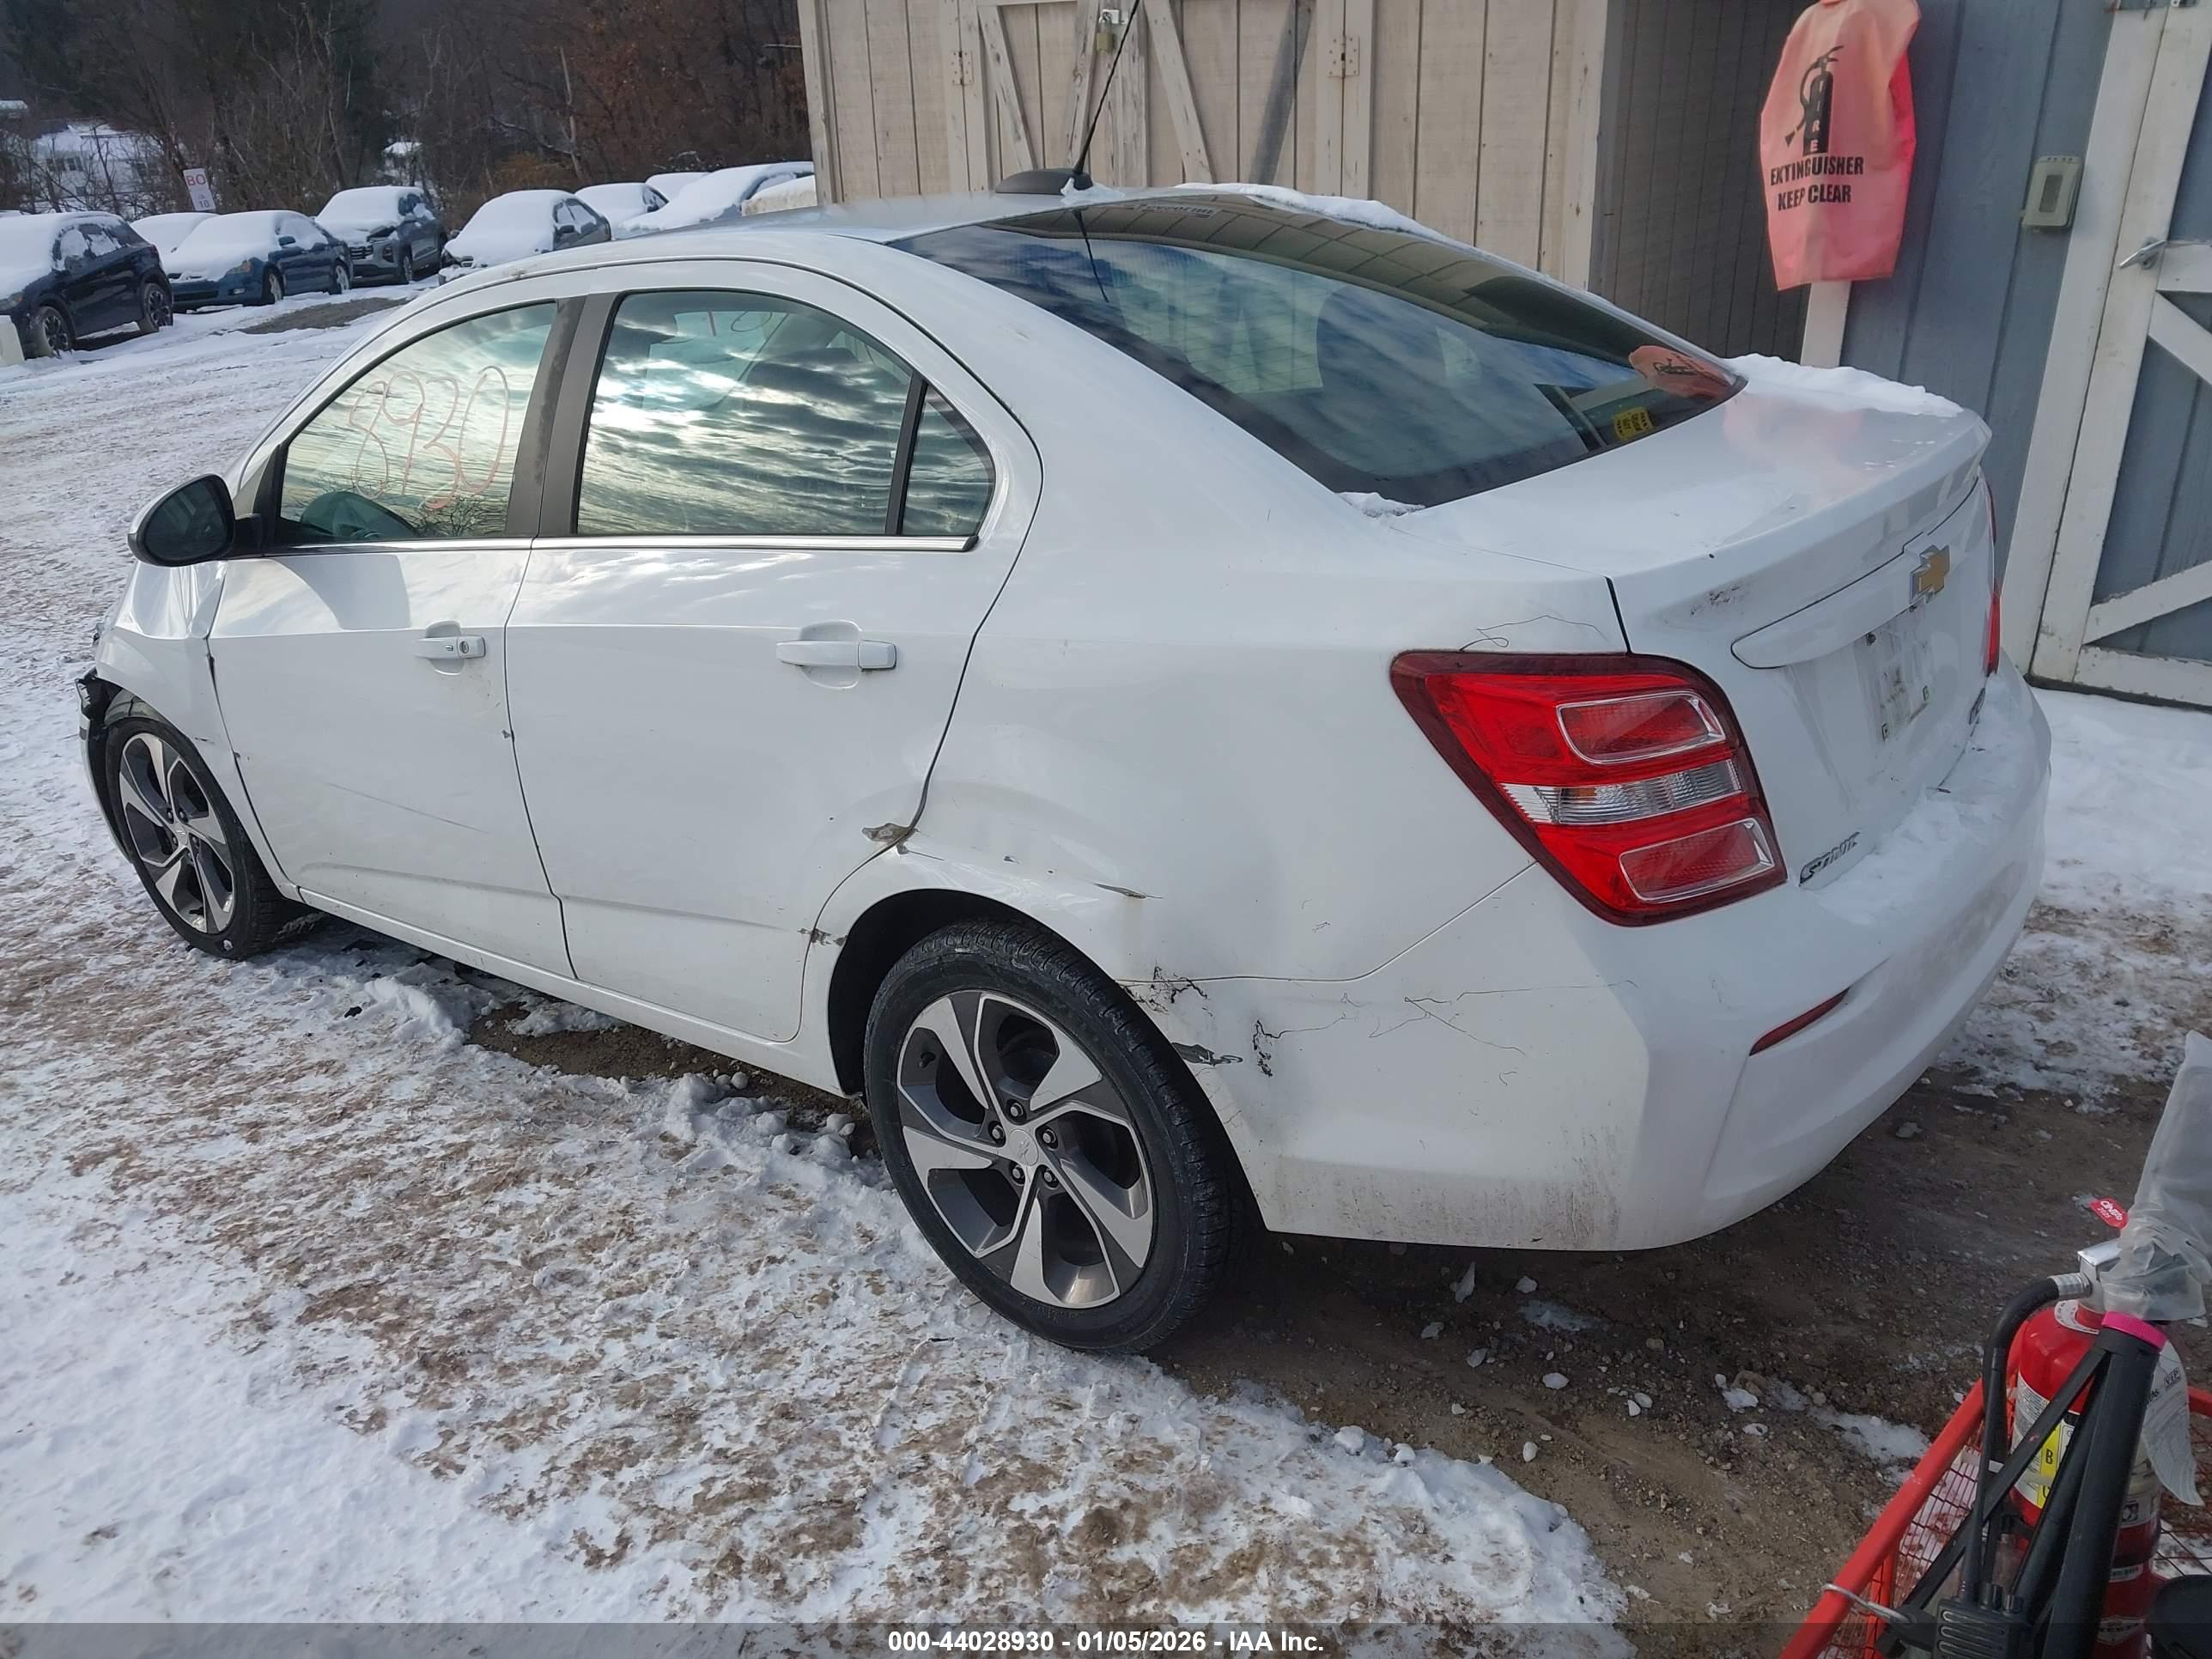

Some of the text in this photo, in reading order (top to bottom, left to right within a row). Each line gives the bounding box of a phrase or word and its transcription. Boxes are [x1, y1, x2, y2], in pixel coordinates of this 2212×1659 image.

[1771, 156, 1864, 185] EXTINGUISHER
[1778, 184, 1851, 211] KEEP CLEAR
[349, 366, 509, 509] 8930
[2045, 1449, 2054, 1465] B
